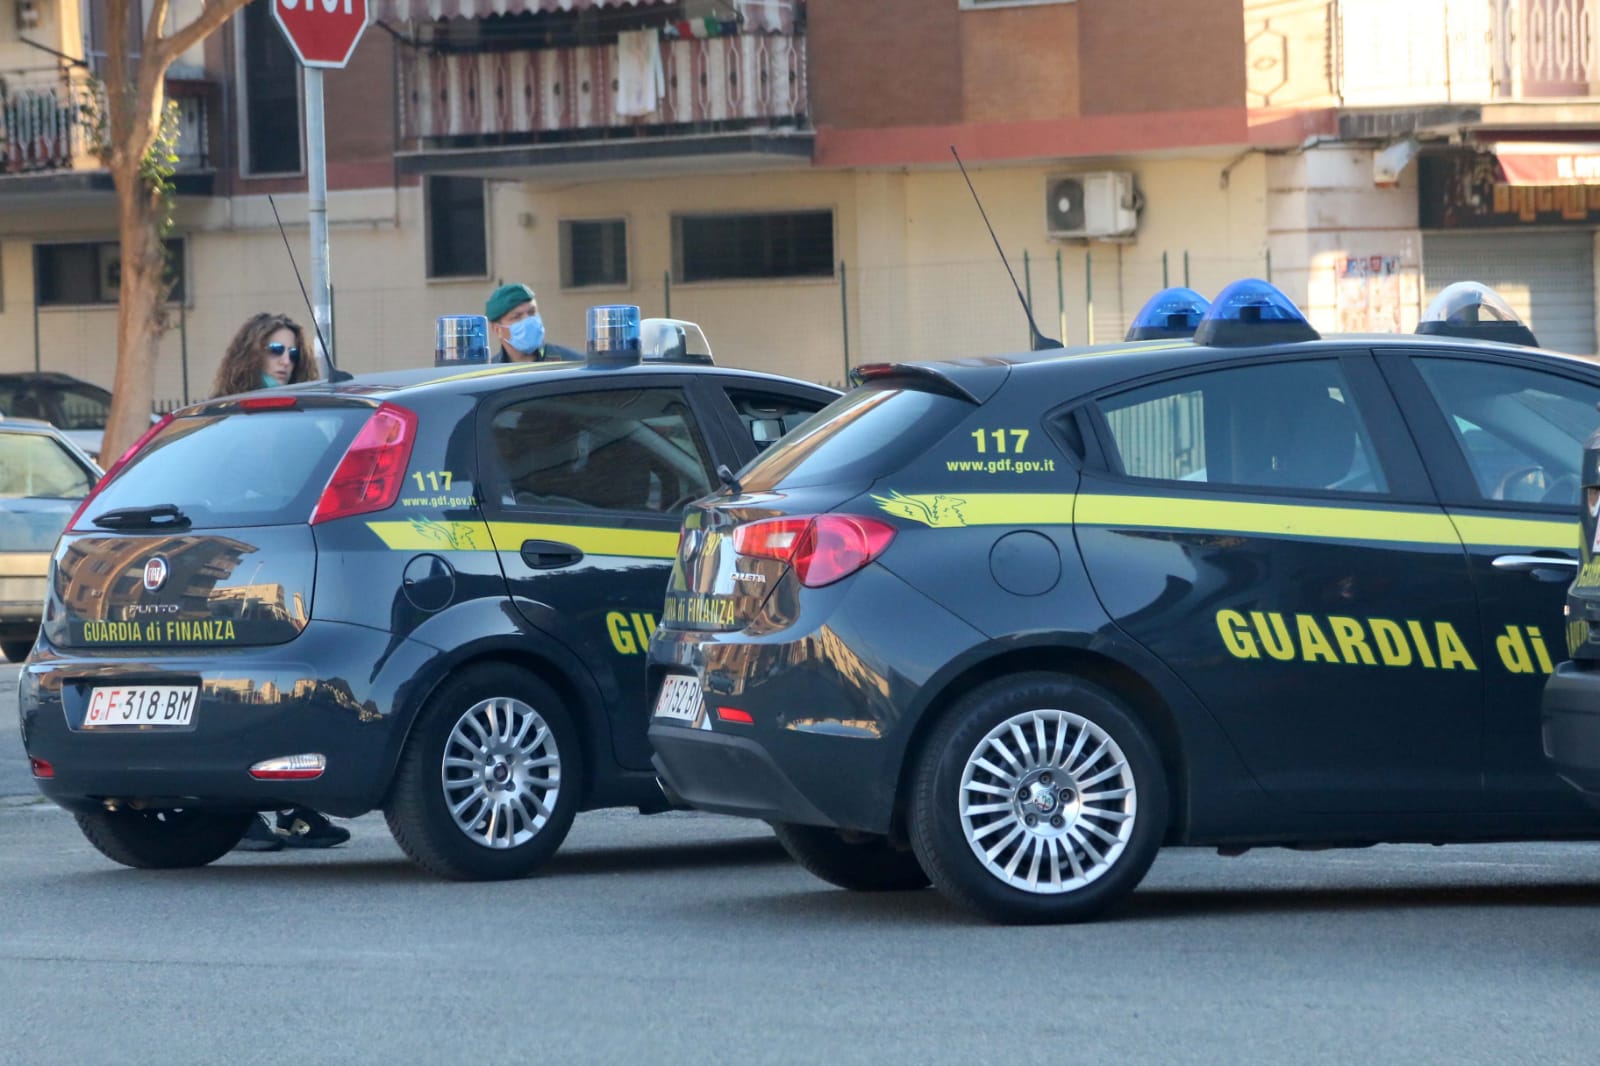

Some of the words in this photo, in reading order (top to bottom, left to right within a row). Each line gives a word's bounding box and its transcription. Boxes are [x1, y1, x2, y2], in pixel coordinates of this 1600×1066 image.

[971, 428, 1029, 453] 117
[947, 458, 1055, 474] www.gdf.gov.it
[412, 471, 452, 491] 117
[402, 495, 478, 508] www.gdf.gov.it
[687, 597, 736, 625] FINANZA
[83, 621, 142, 641] GUARDIA
[146, 621, 161, 641] di
[166, 620, 236, 641] FINANZA
[1215, 608, 1478, 672] GUARDIA
[1495, 624, 1554, 674] di
